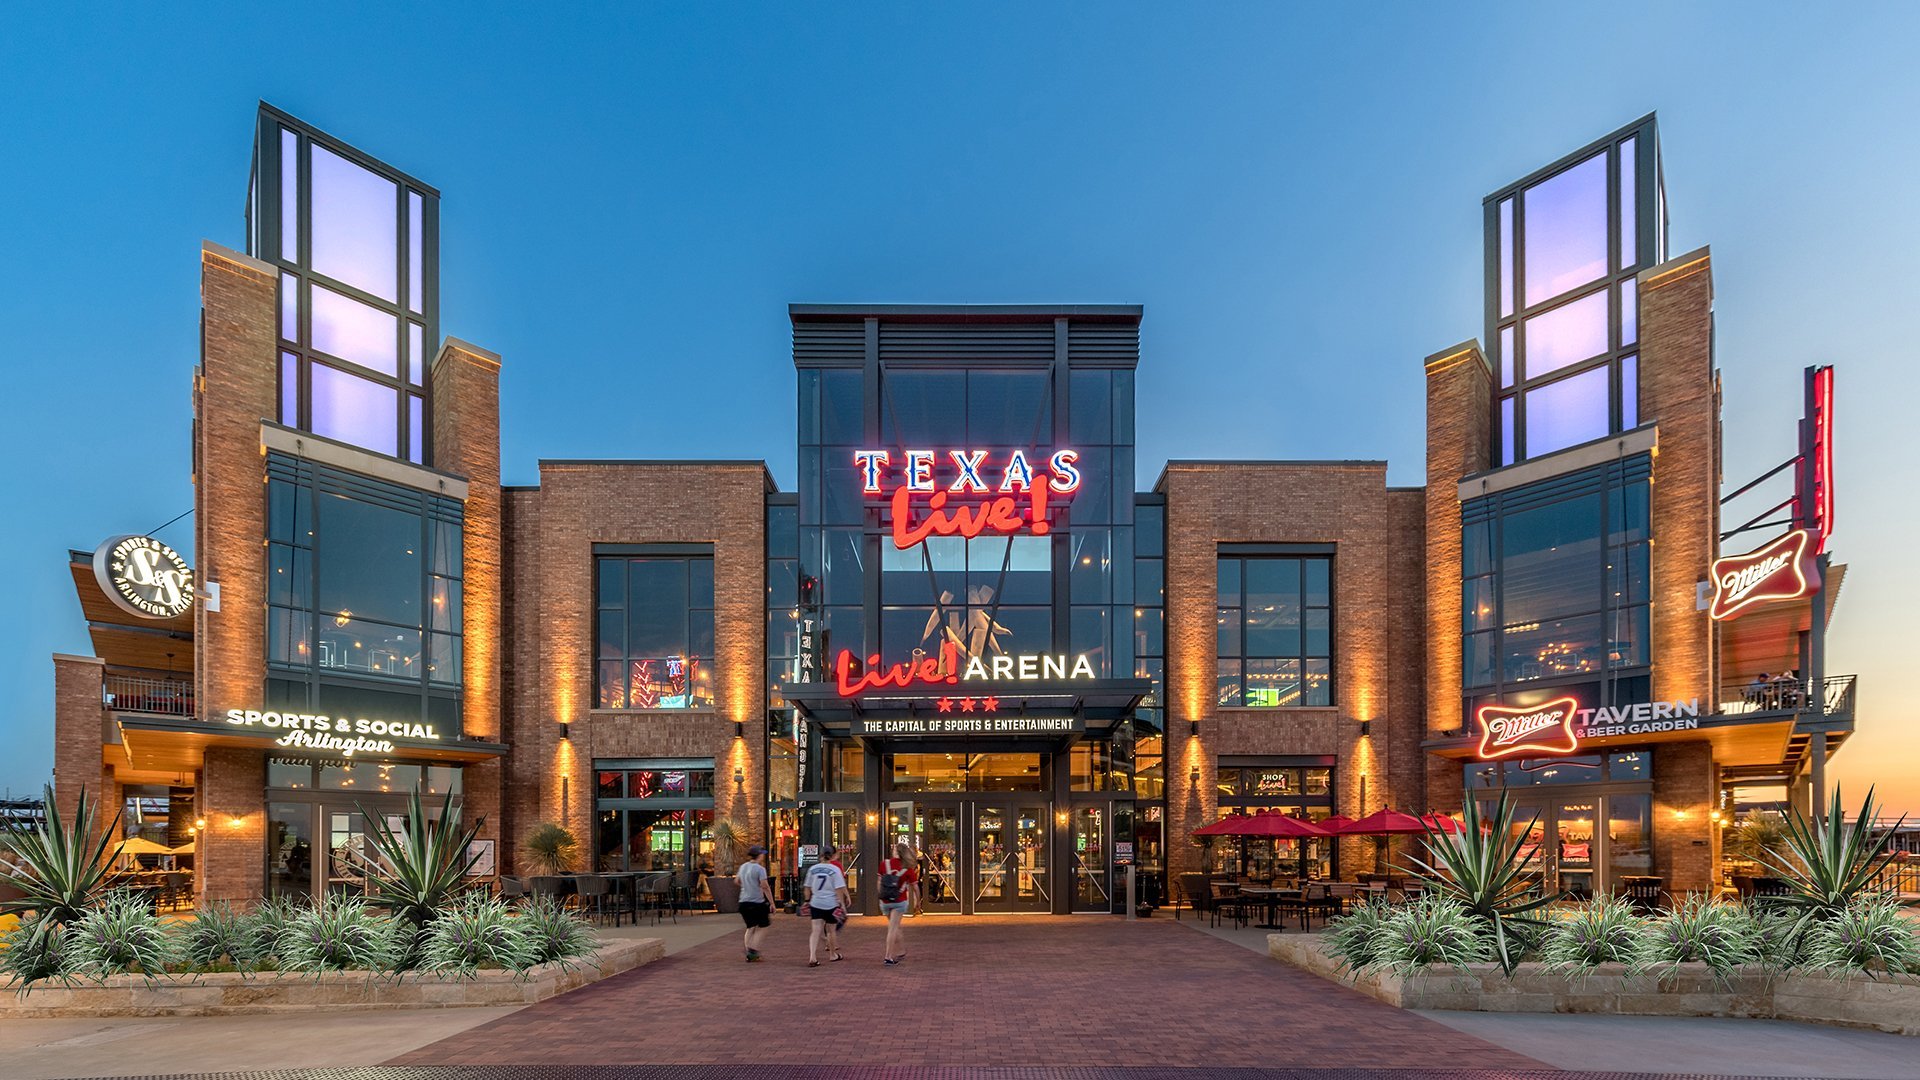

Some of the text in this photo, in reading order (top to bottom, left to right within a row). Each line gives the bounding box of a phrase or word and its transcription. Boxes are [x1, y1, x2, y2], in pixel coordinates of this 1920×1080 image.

[855, 449, 1081, 494] TEXAS
[891, 475, 1049, 550] Live!
[113, 537, 192, 579] SPORTS & SOCIAL
[1721, 550, 1793, 605] Miller
[171, 592, 194, 614] TEXAS
[837, 641, 1096, 696] Live! ARENA
[226, 708, 440, 740] SPORTS & SOCIAL
[864, 719, 1074, 732] THE CAPITAL OF SPORTS & ENTERTAINMENT
[1489, 698, 1699, 746] Miller TAVERN
[1576, 718, 1699, 739] & BEER GARDEN
[275, 729, 395, 756] Arlington
[1260, 778, 1287, 791] Live!
[817, 875, 827, 890] 7
